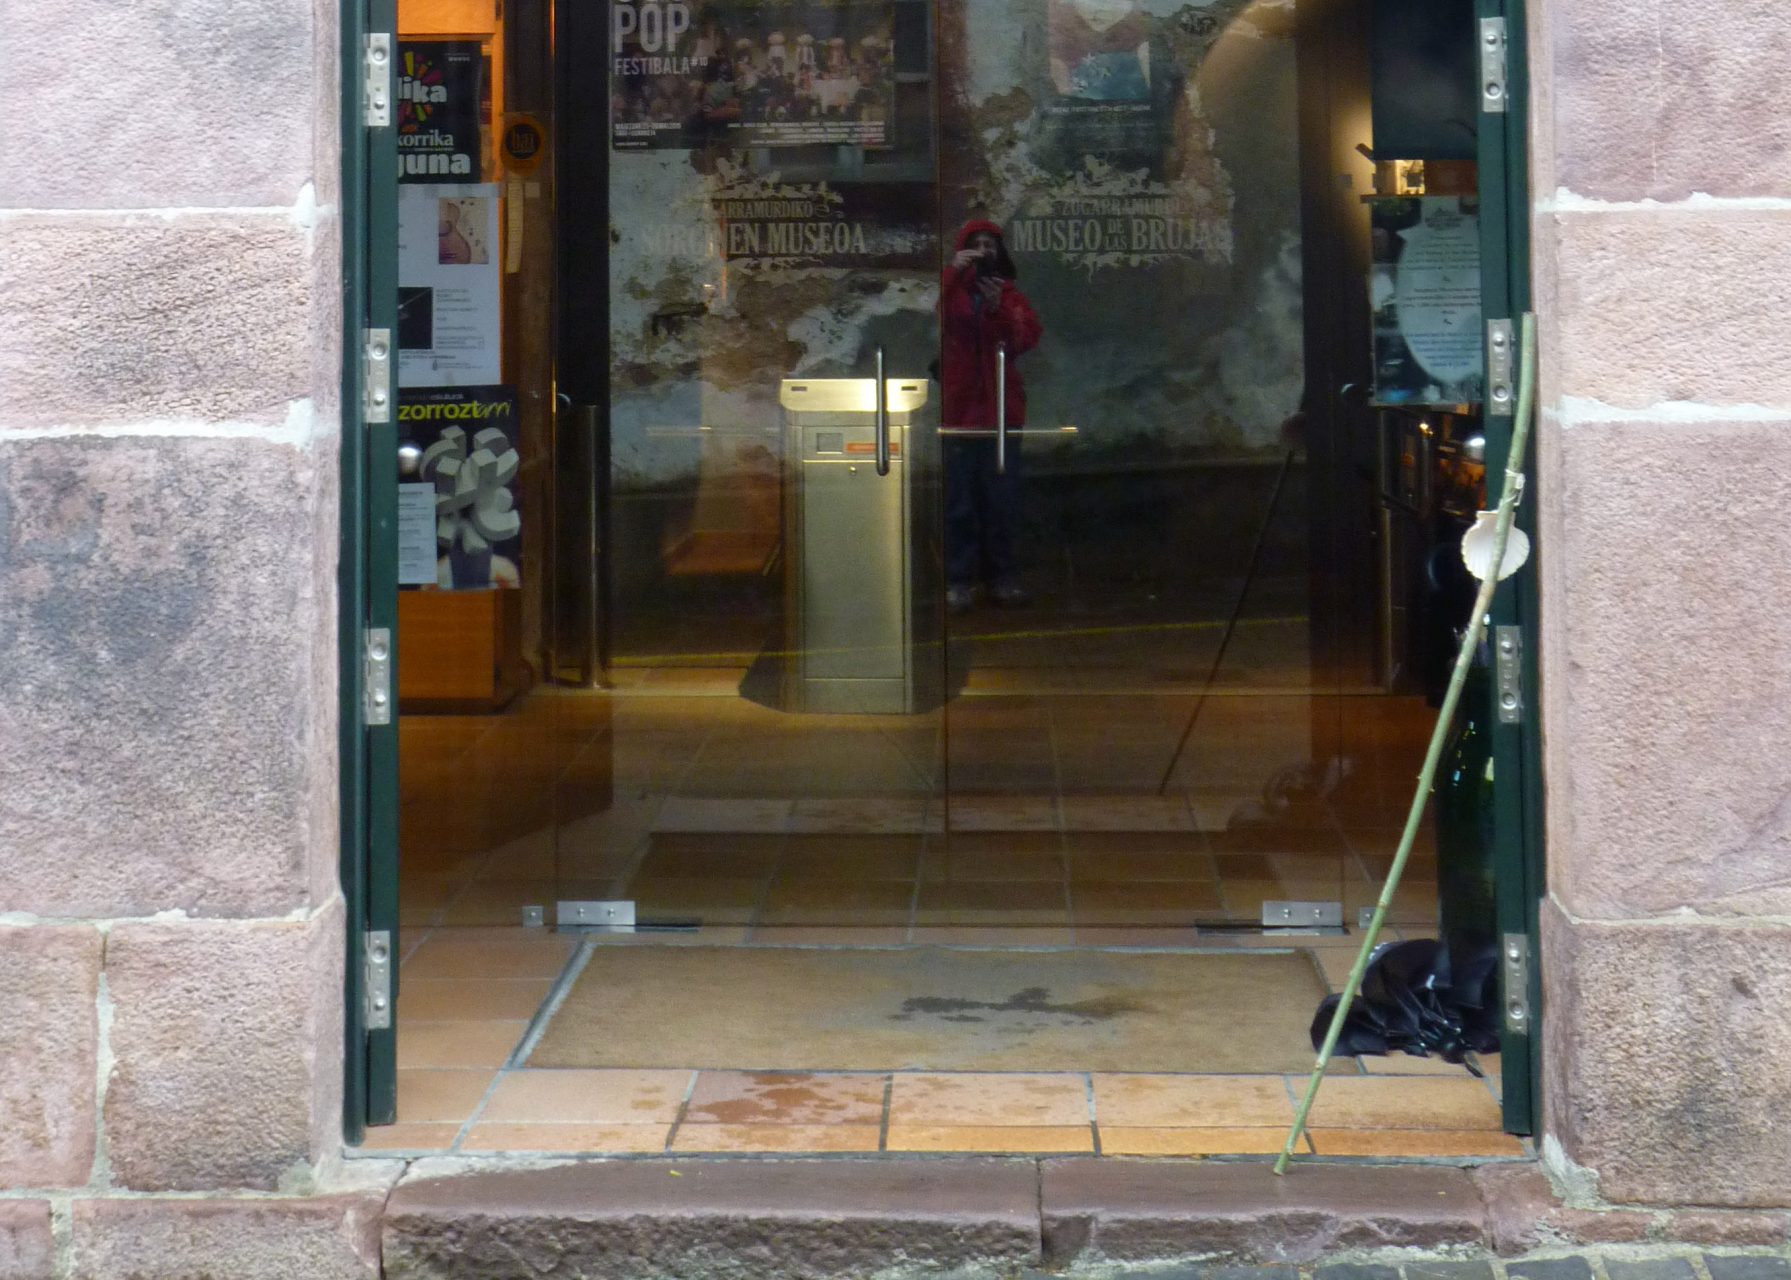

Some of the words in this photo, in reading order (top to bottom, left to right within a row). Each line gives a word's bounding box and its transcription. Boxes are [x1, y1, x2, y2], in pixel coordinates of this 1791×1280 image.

[614, 4, 690, 53] POP
[615, 57, 690, 75] FESTIBALA
[767, 222, 867, 255] MUSEOA
[1012, 218, 1103, 252] MUSEO
